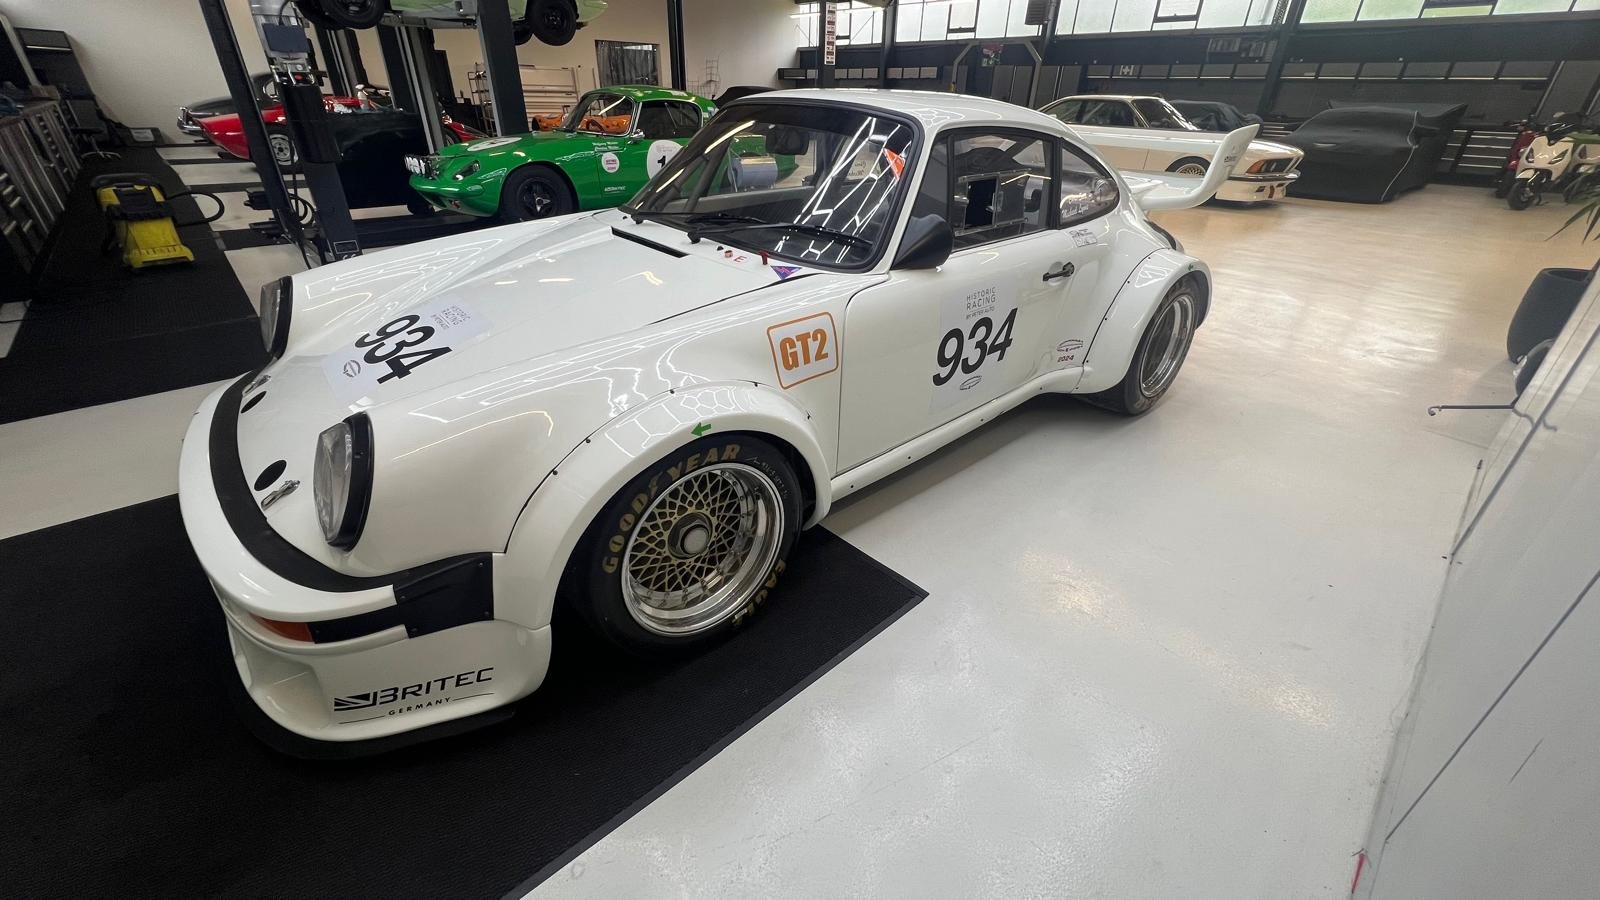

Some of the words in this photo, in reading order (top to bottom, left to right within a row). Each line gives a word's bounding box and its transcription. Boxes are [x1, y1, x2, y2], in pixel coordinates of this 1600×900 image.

[966, 287, 996, 301] HISTORIC
[966, 294, 996, 311] RACING
[354, 314, 453, 385] 934
[780, 328, 829, 371] GT2
[932, 307, 1018, 387] 934
[372, 667, 494, 706] BRITEC
[388, 697, 452, 716] GERMANY
